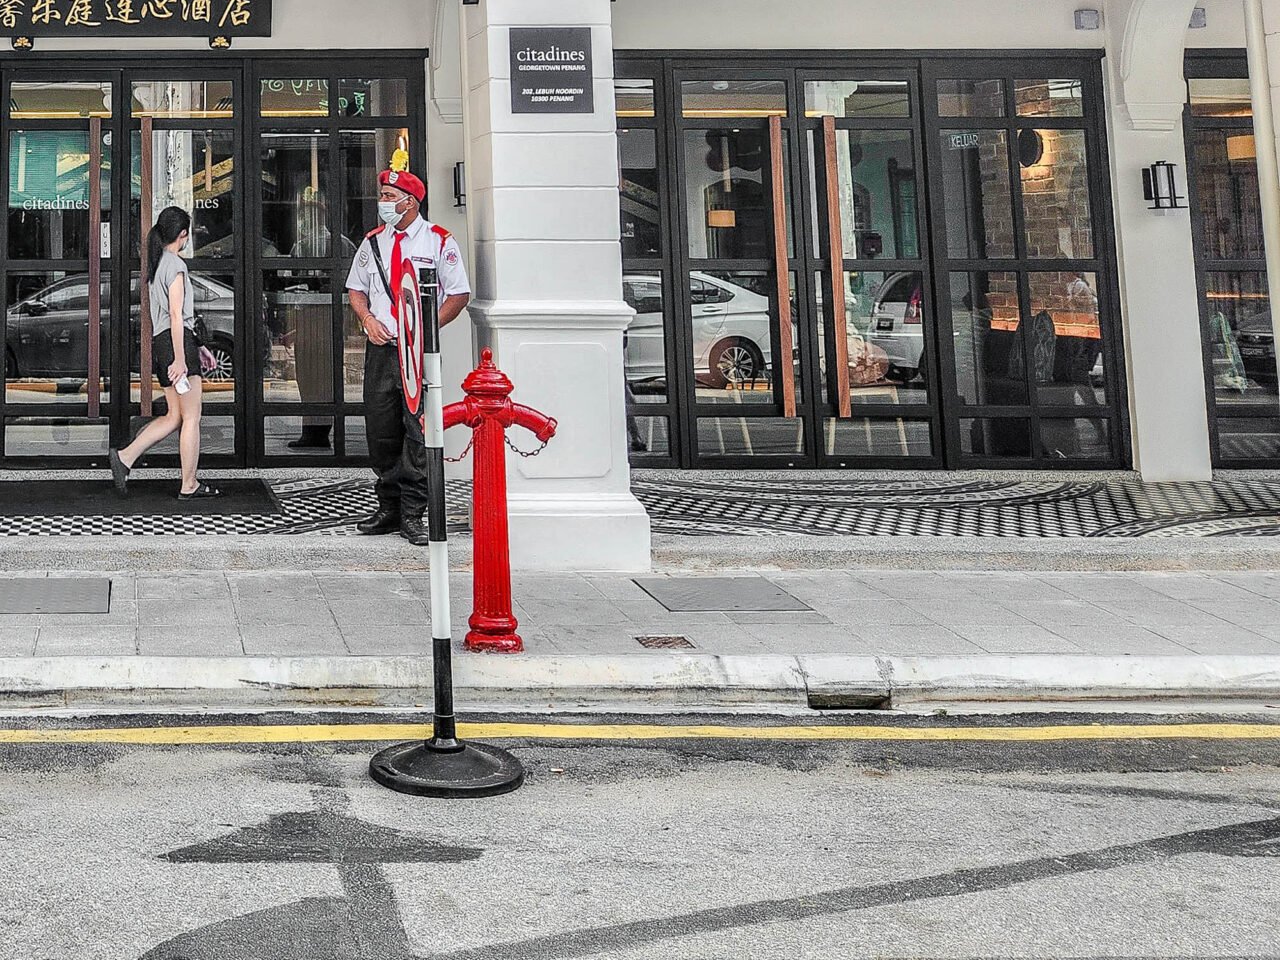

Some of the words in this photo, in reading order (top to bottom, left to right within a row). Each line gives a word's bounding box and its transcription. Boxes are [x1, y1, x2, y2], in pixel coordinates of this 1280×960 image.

[516, 45, 585, 62] citadines
[518, 64, 560, 72] GEORGETOWN
[951, 133, 979, 148] KELUAR
[22, 194, 90, 210] citadines
